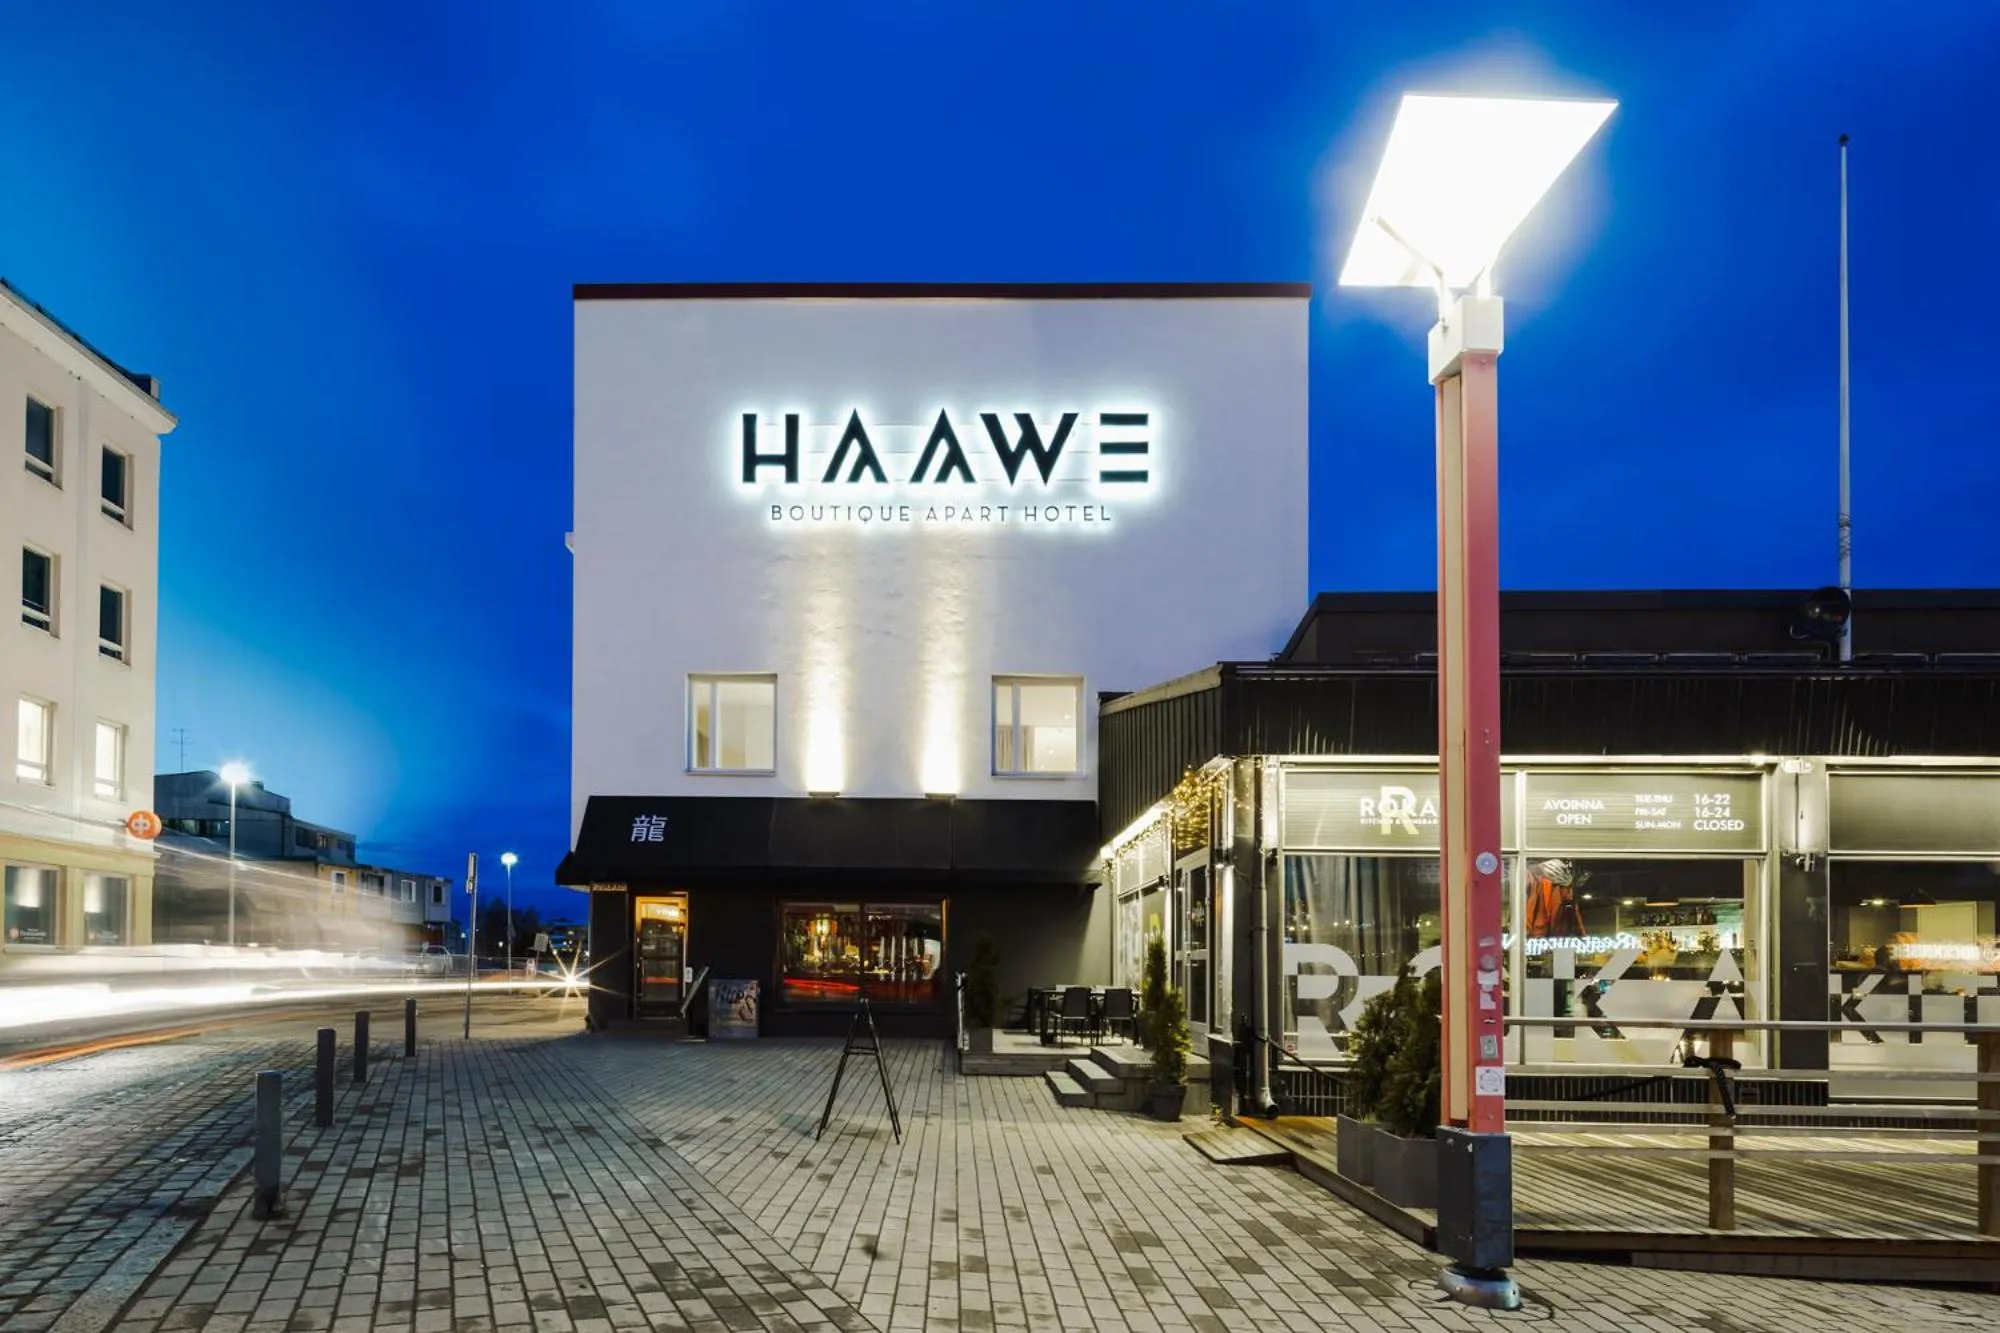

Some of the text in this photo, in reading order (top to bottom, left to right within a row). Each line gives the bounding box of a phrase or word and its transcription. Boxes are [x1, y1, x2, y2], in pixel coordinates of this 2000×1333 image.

[742, 408, 1148, 486] HAAWE
[771, 505, 1111, 524] BOUTIQUE APART HOTEL
[1544, 800, 1604, 811] AVOINNA
[1694, 794, 1730, 805] 16-22
[1694, 807, 1730, 818] 16-24
[1556, 813, 1592, 825] OPEN
[1694, 819, 1744, 831] CLOSED
[631, 814, 668, 842] 龍
